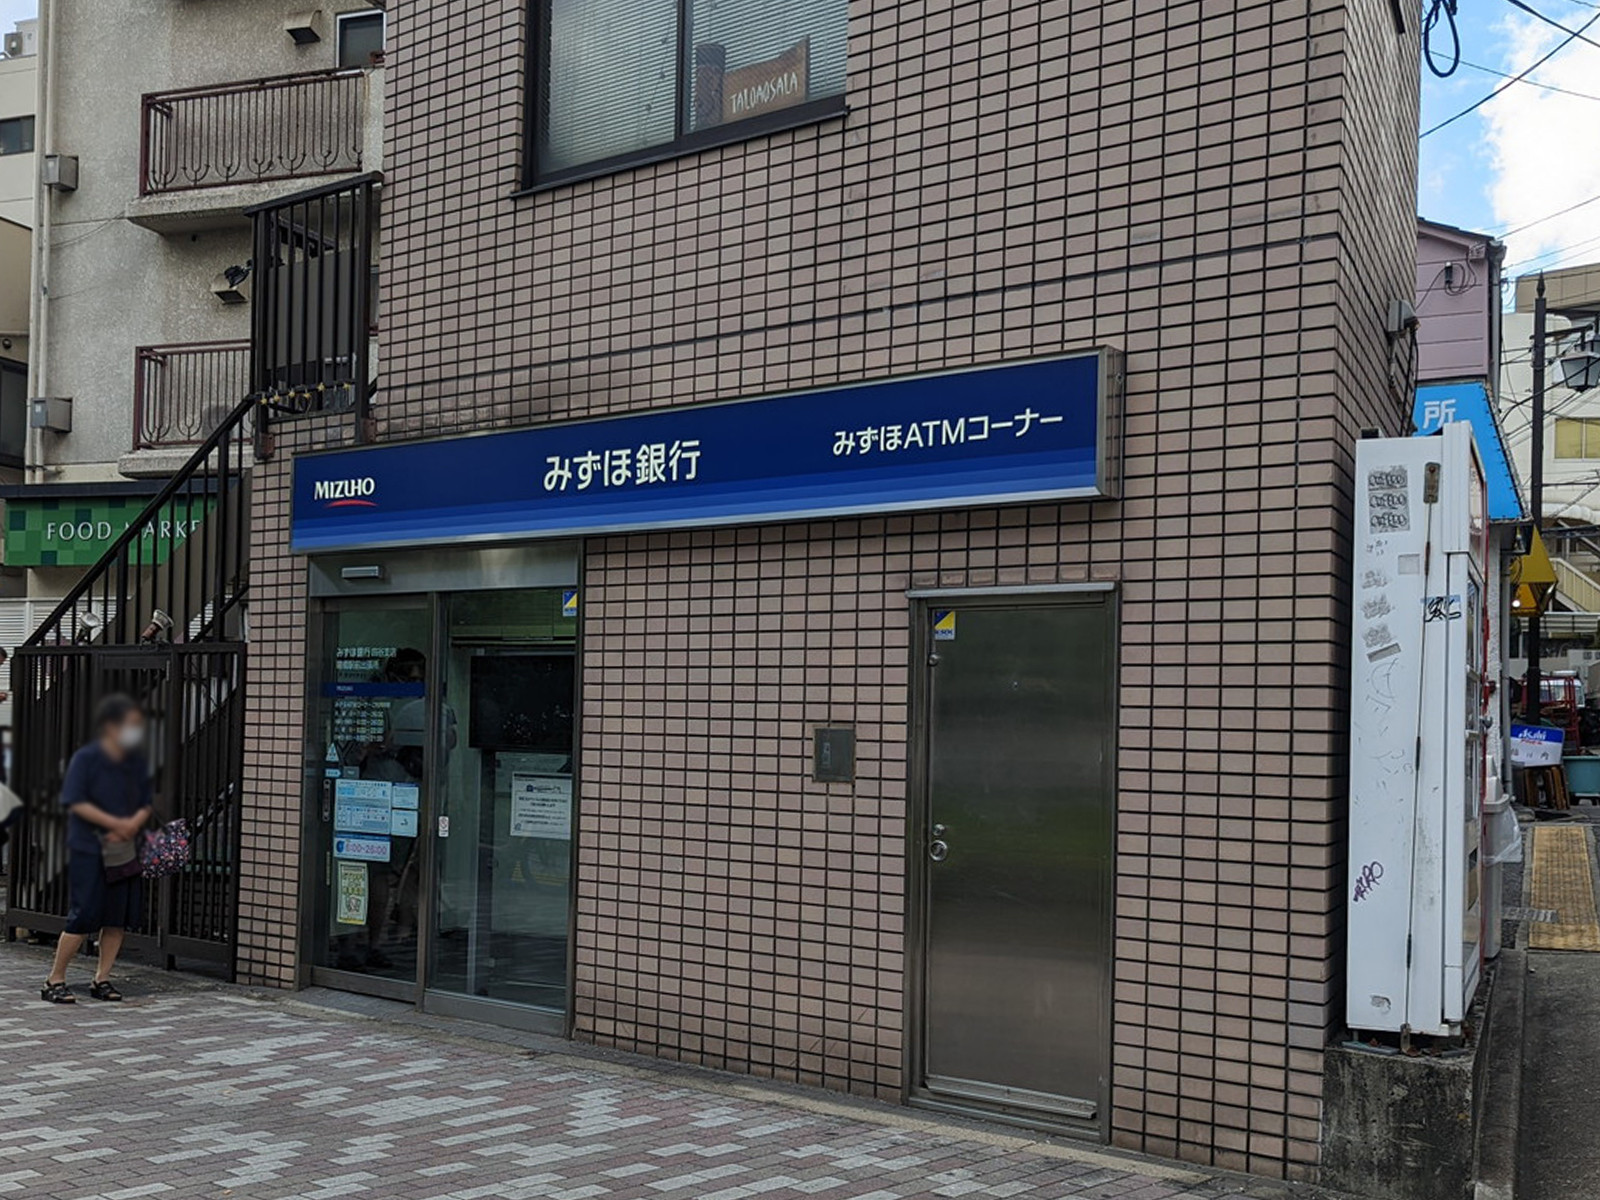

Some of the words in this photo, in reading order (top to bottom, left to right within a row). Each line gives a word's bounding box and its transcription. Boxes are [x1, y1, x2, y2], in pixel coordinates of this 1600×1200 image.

[1423, 399, 1456, 429] 所
[832, 408, 1063, 456] みずほATMコーナー
[543, 440, 701, 491] みずほ銀行
[314, 477, 375, 500] MIZUHO
[47, 521, 112, 540] FOOD
[125, 519, 201, 539] ARK
